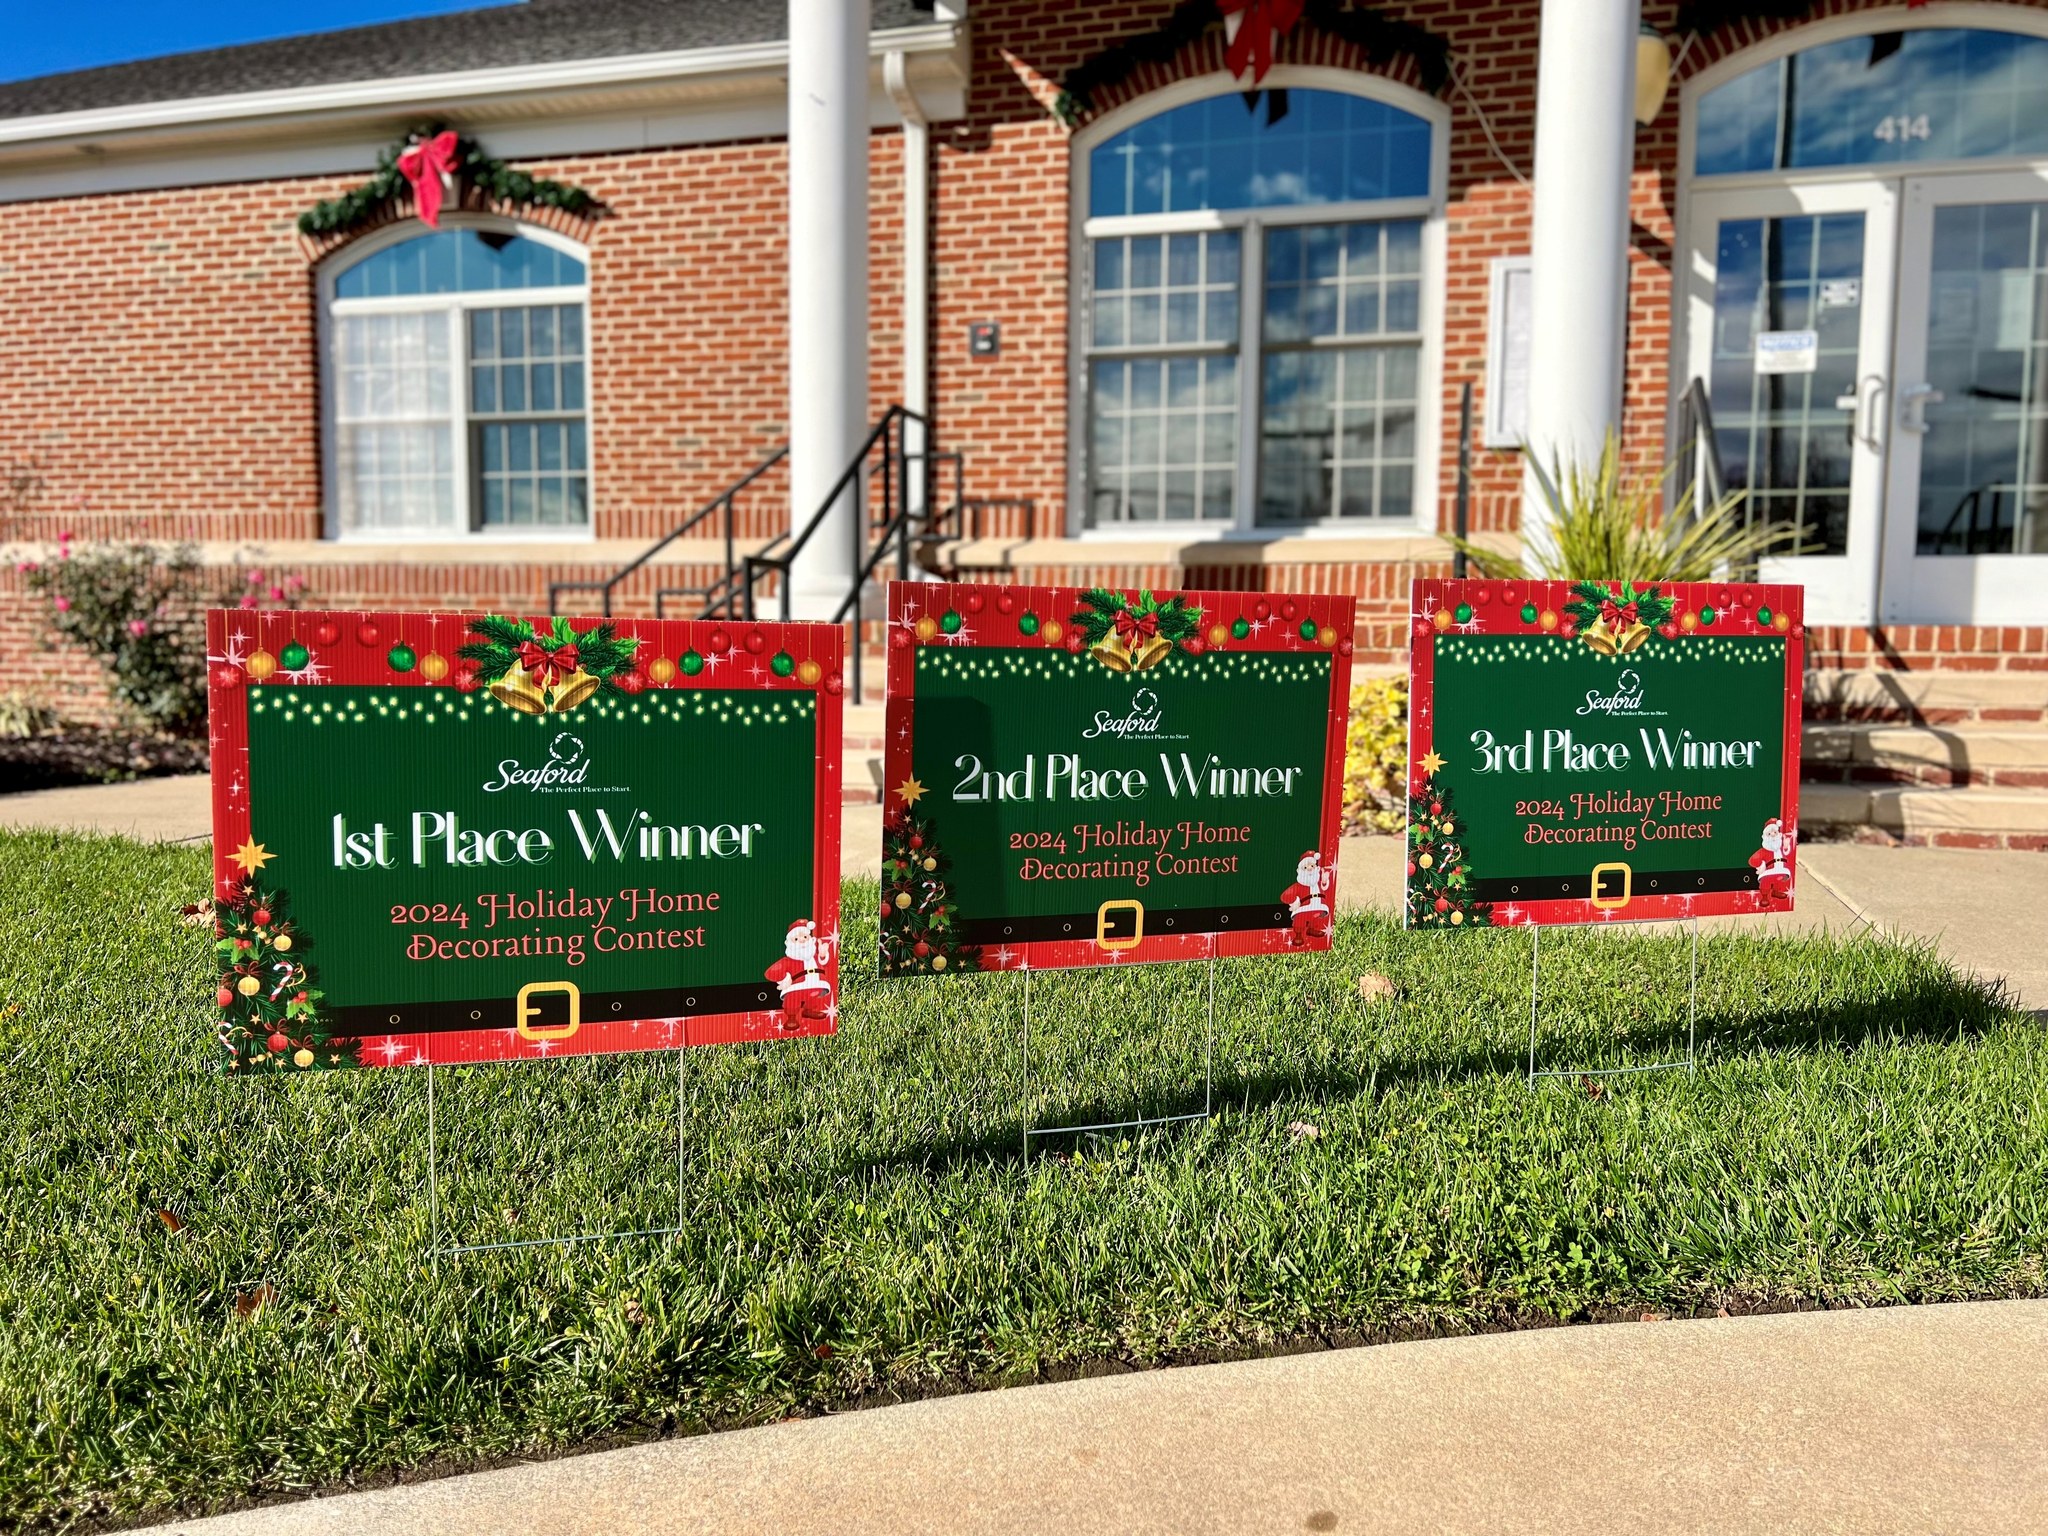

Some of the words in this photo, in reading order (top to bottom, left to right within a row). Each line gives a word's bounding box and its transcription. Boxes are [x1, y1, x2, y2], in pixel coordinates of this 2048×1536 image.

[1873, 114, 1932, 142] 414
[1576, 689, 1644, 716] Seaford
[1082, 710, 1162, 739] Seaford
[1470, 729, 1532, 772] 3rd
[1543, 729, 1630, 771] Place
[1639, 728, 1760, 769] Winner
[482, 758, 590, 792] Seaford
[952, 753, 1034, 800] 2nd
[1046, 753, 1147, 799] Place
[1159, 752, 1302, 798] Winner
[1515, 800, 1565, 821] 2024
[1570, 790, 1655, 821] Holiday
[1659, 791, 1722, 817] Home
[333, 812, 397, 868] 1st
[412, 811, 553, 866] Place
[567, 808, 763, 862] Winner
[1010, 831, 1067, 854] 2024
[1073, 821, 1173, 854] Holiday
[1177, 822, 1251, 850] Home
[1524, 820, 1636, 851] Decorating
[1641, 820, 1712, 839] Contest
[1019, 853, 1150, 887] Decorating
[1156, 853, 1238, 876] Contest
[390, 902, 469, 929] 2024
[477, 888, 614, 929] Holiday
[619, 887, 720, 922] Home
[406, 927, 587, 966] Decorating
[593, 925, 706, 953] Contest
